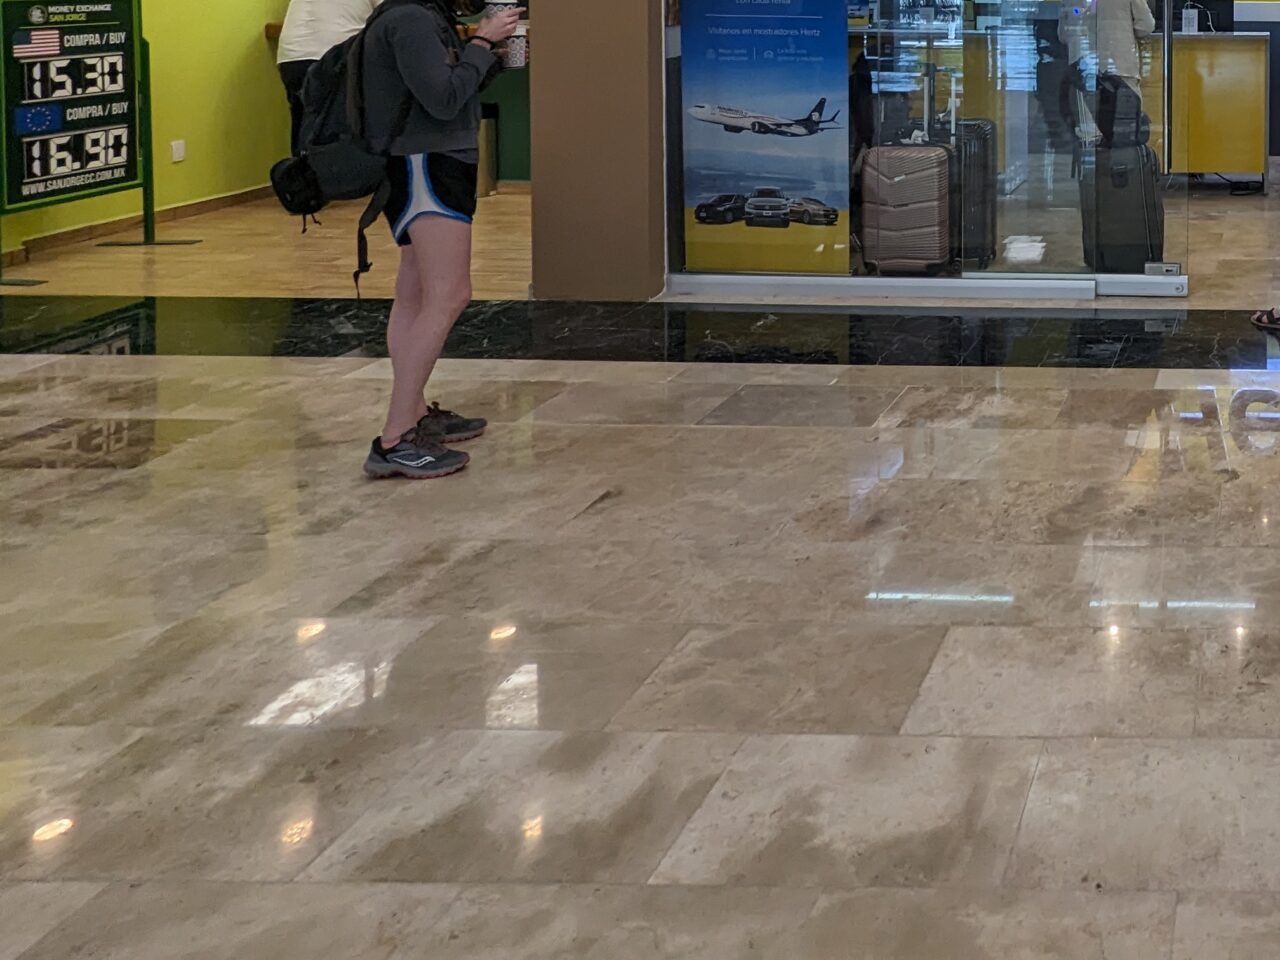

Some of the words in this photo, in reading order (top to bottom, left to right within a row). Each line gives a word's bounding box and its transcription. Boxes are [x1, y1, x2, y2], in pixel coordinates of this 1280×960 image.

[48, 5, 74, 14] MONEY
[76, 3, 112, 12] EXCHANGE
[49, 14, 65, 22] SAN
[65, 13, 87, 21] JORGE
[64, 34, 101, 47] COMPRA
[102, 33, 108, 44] /
[109, 32, 126, 44] BUY
[33, 56, 124, 98] 15.30
[66, 108, 104, 121] COMPRA
[105, 104, 111, 116] /
[112, 102, 129, 114] BUY
[32, 128, 128, 176] 16.90
